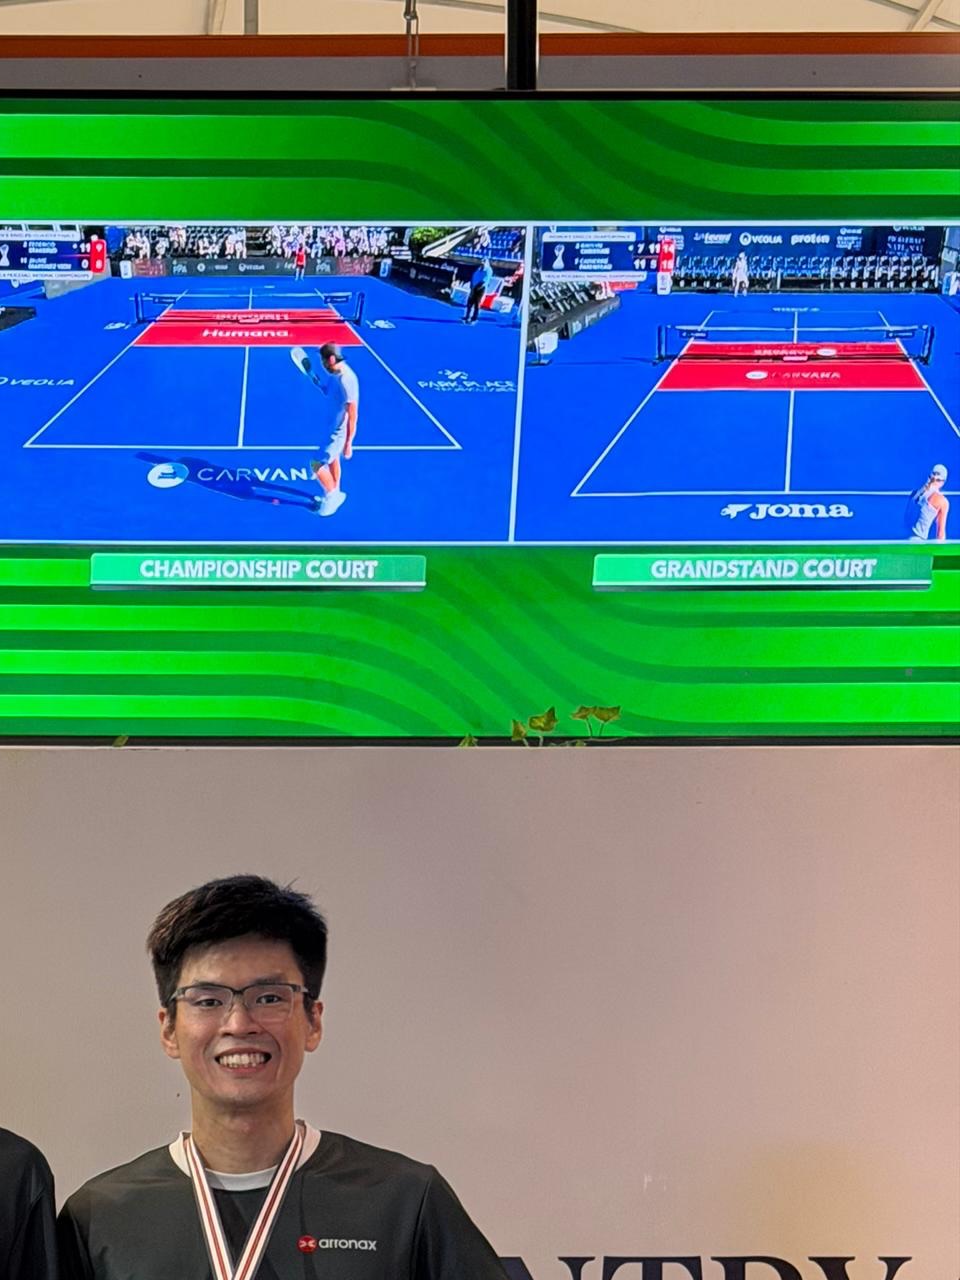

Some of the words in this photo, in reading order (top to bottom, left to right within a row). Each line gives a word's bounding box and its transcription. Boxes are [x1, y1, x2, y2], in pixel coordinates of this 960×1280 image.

[202, 328, 289, 337] Humana
[139, 559, 301, 579] CHAMPIONSHIP
[305, 559, 379, 579] COURT
[650, 559, 797, 579] GRANDSTAND
[802, 558, 877, 578] COURT
[318, 1238, 377, 1252] arronax
